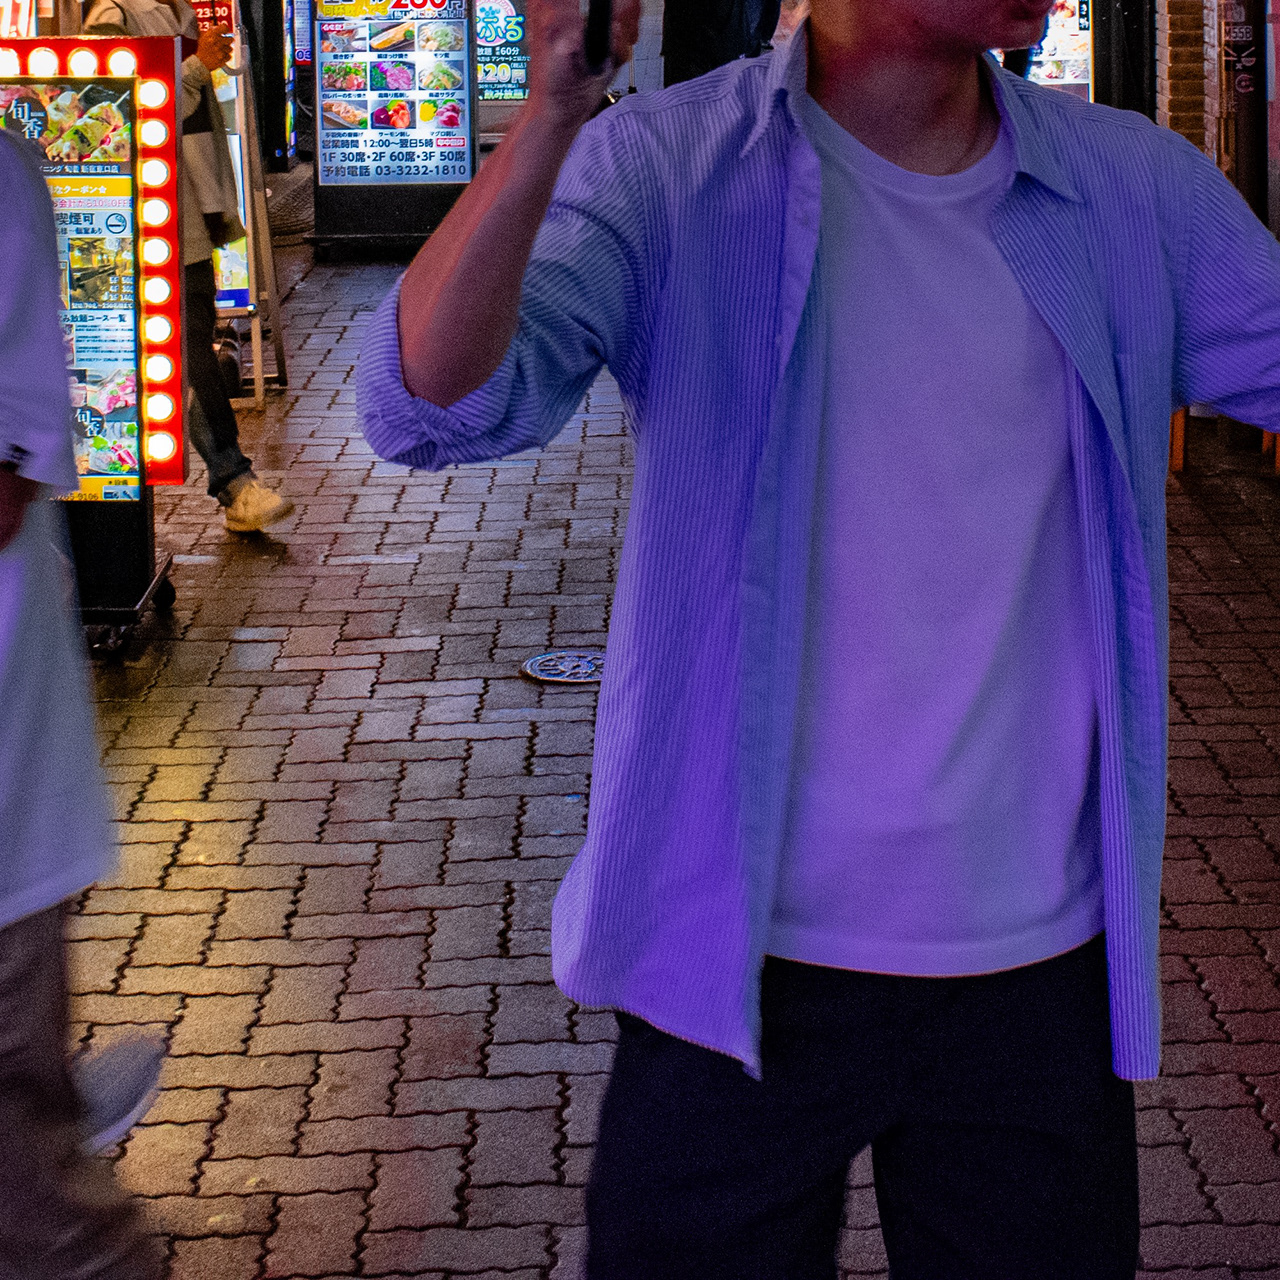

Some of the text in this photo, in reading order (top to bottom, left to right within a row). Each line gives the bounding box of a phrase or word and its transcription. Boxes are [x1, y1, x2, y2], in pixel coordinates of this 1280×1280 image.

[197, 6, 229, 18] 23:00
[321, 138, 360, 149] 営業時間
[322, 152, 336, 163] 1F
[439, 150, 466, 162] 50席
[322, 165, 467, 177] 予約電話 03-3232-1810
[55, 212, 95, 225] 喫煙可
